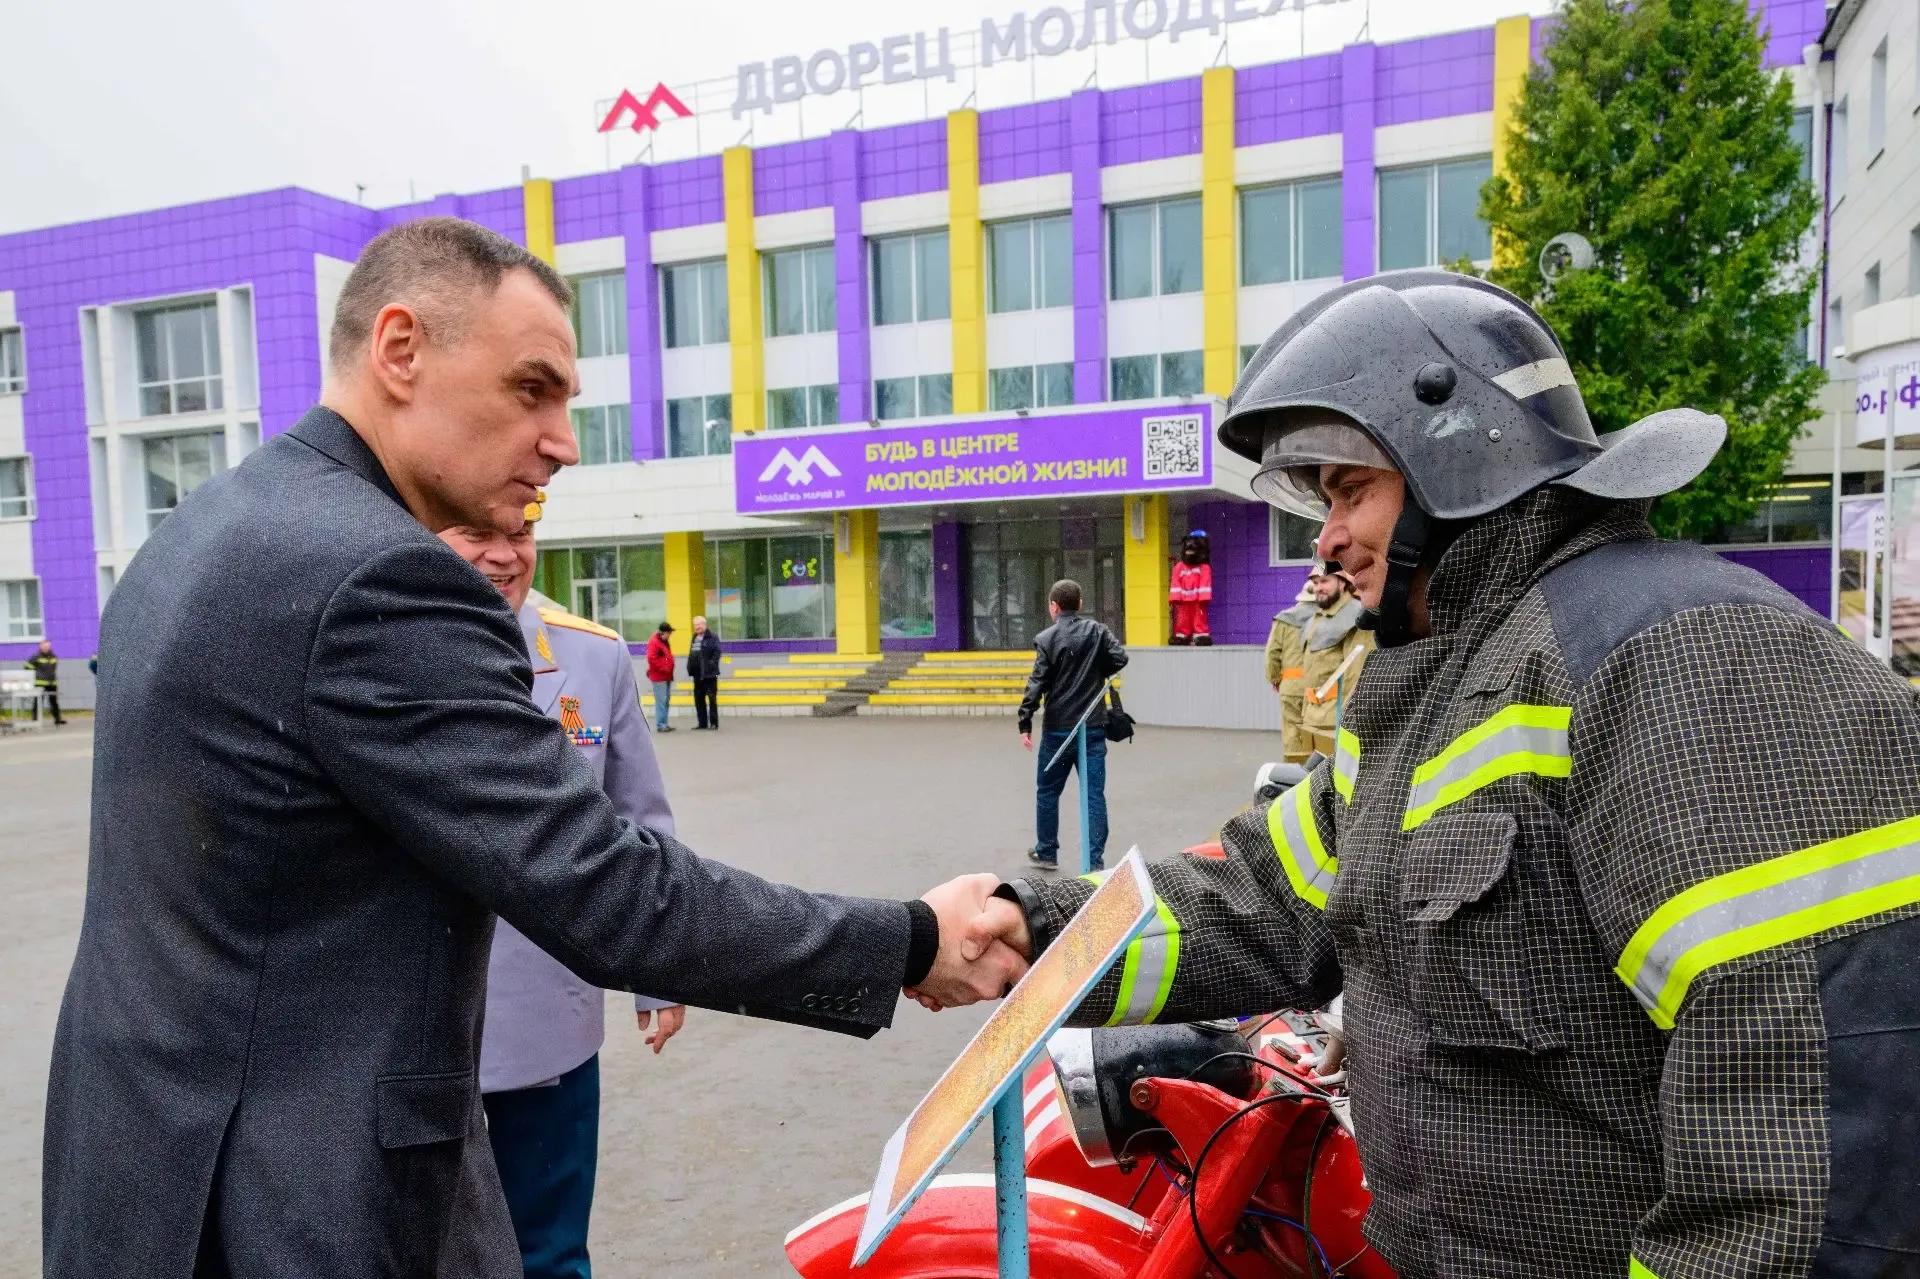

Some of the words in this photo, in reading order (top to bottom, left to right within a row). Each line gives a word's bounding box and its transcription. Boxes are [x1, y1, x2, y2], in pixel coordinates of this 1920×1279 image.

[732, 27, 955, 120] ДВОРЕЦ
[980, 0, 1350, 68] МОЛОД
[865, 441, 918, 463] БУДЬ
[922, 439, 936, 458] В
[940, 432, 1020, 459] ЦЕНТРЕ
[866, 460, 1028, 493] МОЛОДЁЖНОЙ
[1032, 457, 1127, 482] ЖИЗНИ!
